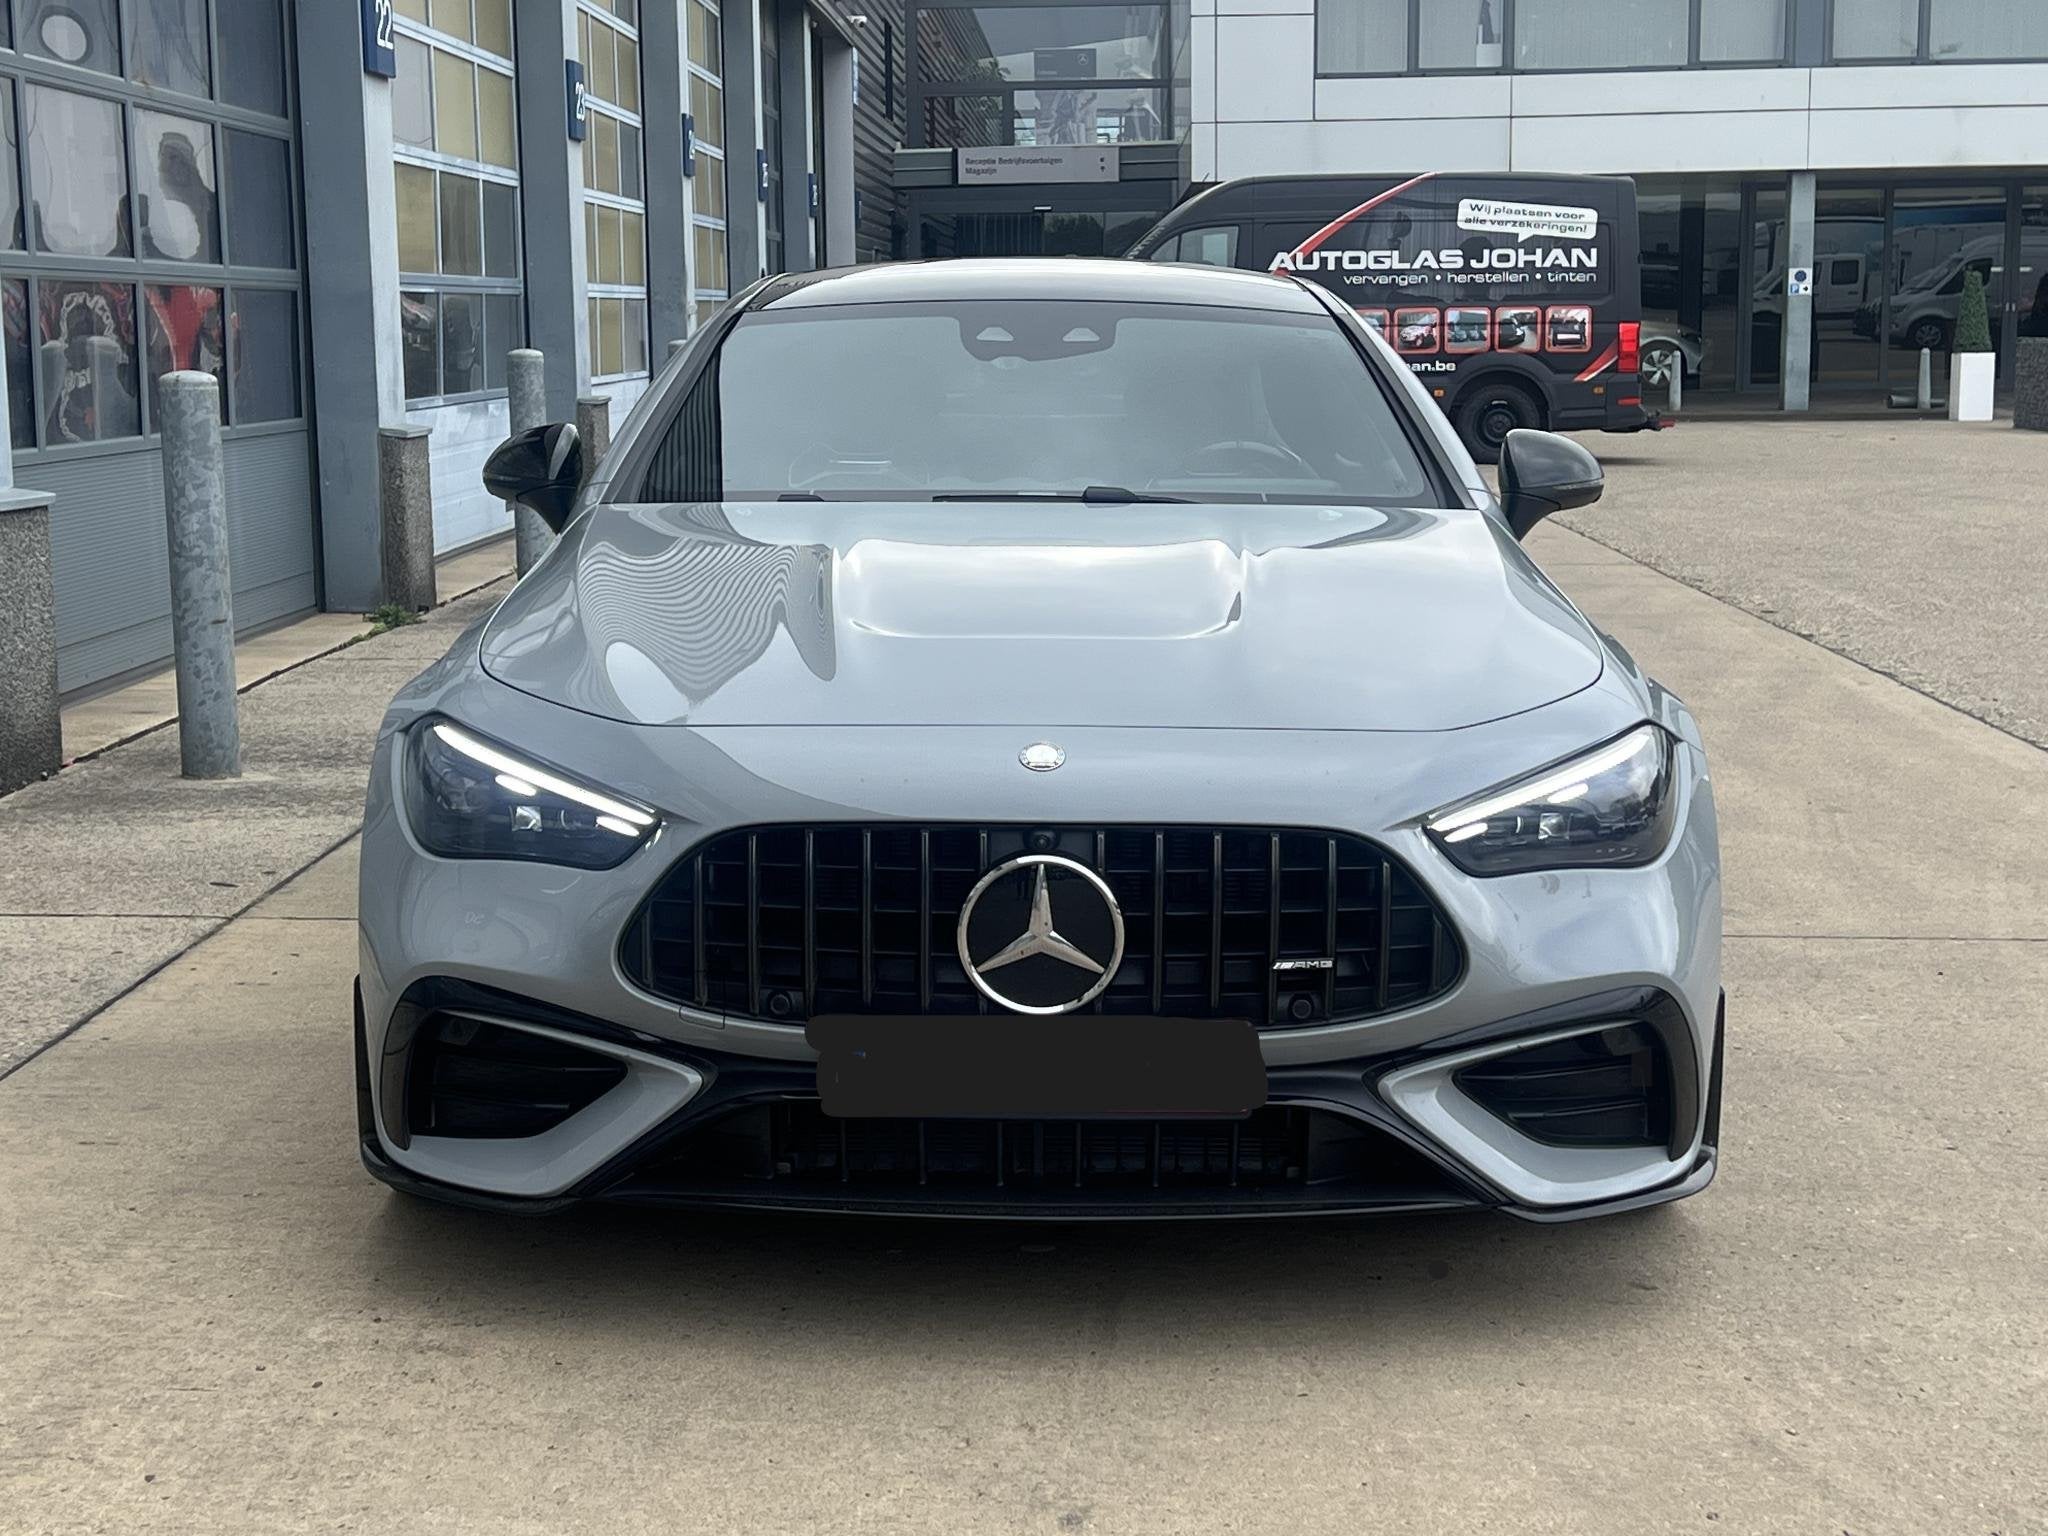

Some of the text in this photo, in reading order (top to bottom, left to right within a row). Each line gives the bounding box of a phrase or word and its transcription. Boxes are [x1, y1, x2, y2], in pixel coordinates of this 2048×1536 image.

[375, 0, 394, 50] 22
[965, 157, 996, 166] Receptie
[965, 167, 997, 176] Magazijn
[1469, 203, 1585, 220] Wij plaatsen voor
[1464, 215, 1588, 234] alle verzekeringen!
[1268, 247, 1598, 270] AUTOGLAS JOHAN
[1343, 270, 1597, 287] vervangen herstellen tinten
